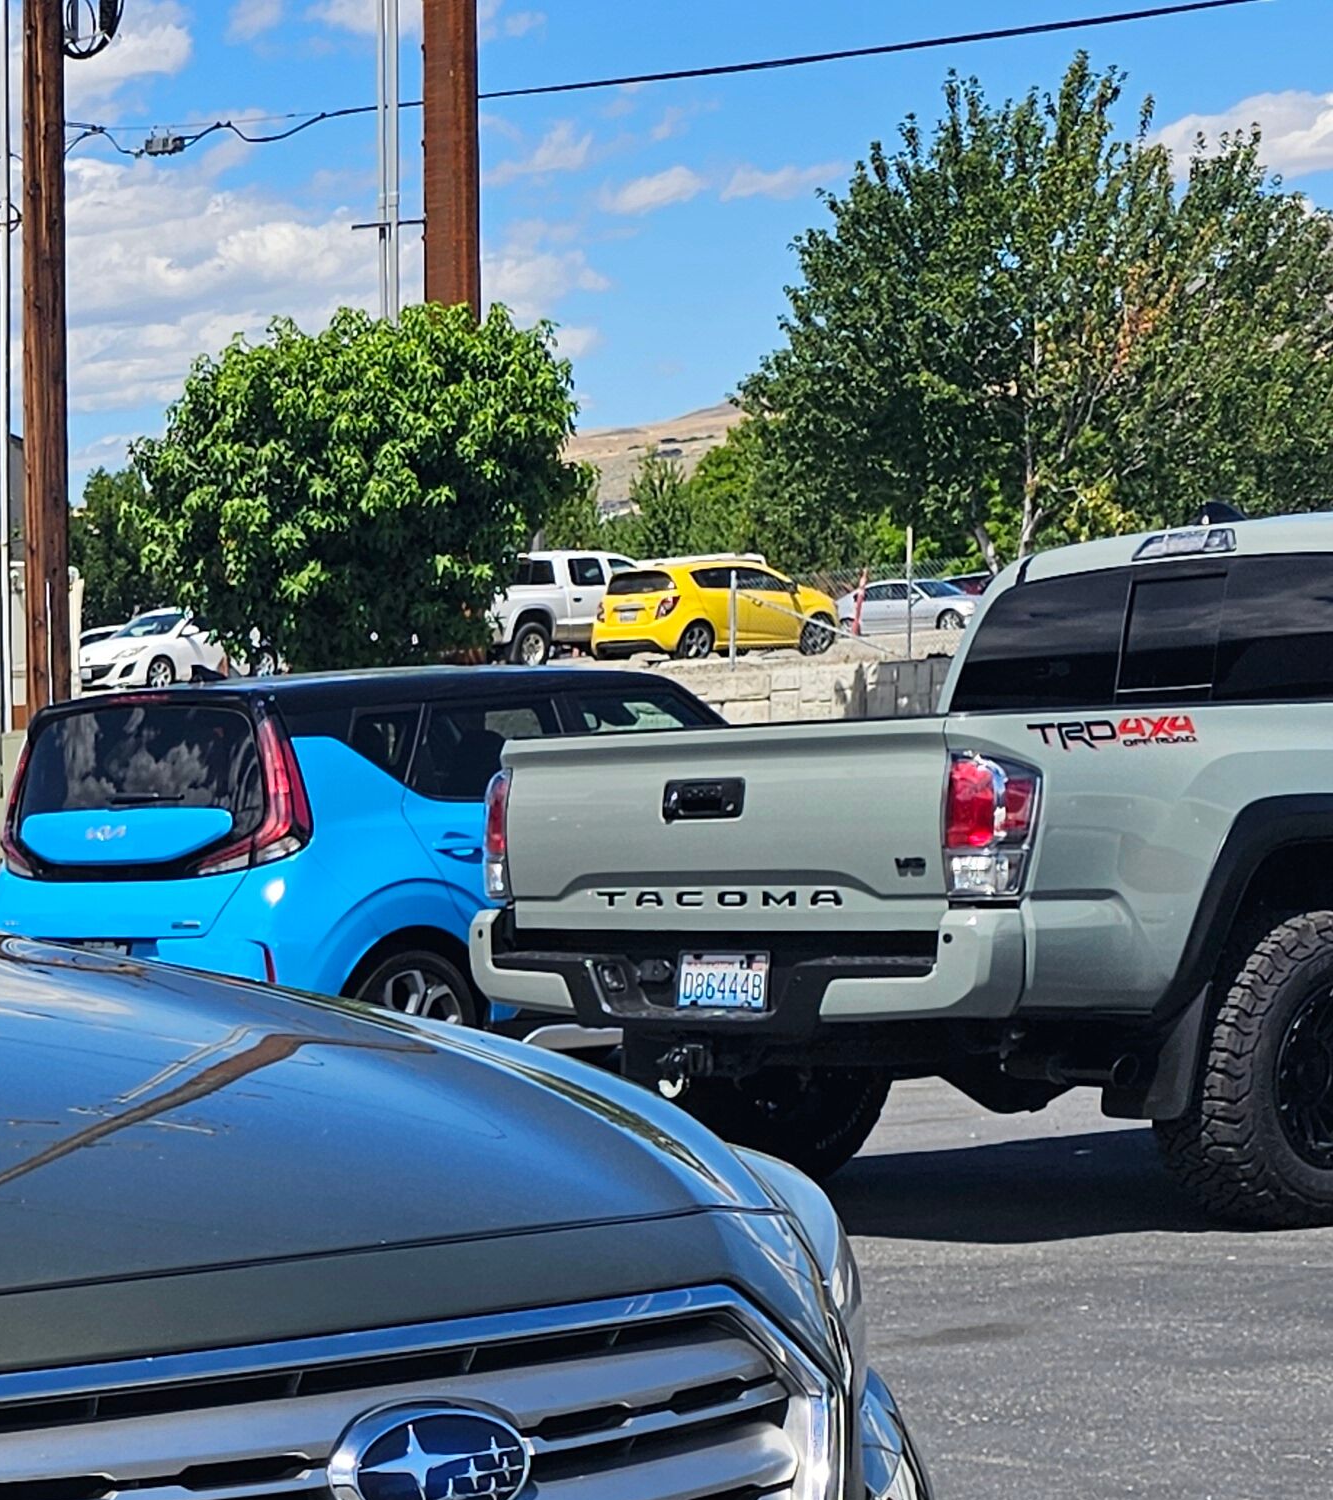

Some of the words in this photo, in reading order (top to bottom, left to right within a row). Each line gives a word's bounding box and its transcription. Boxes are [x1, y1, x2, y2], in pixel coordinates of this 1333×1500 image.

[1026, 720, 1118, 750] TRD
[1155, 734, 1197, 745] ROAD
[596, 890, 844, 907] TACOMA
